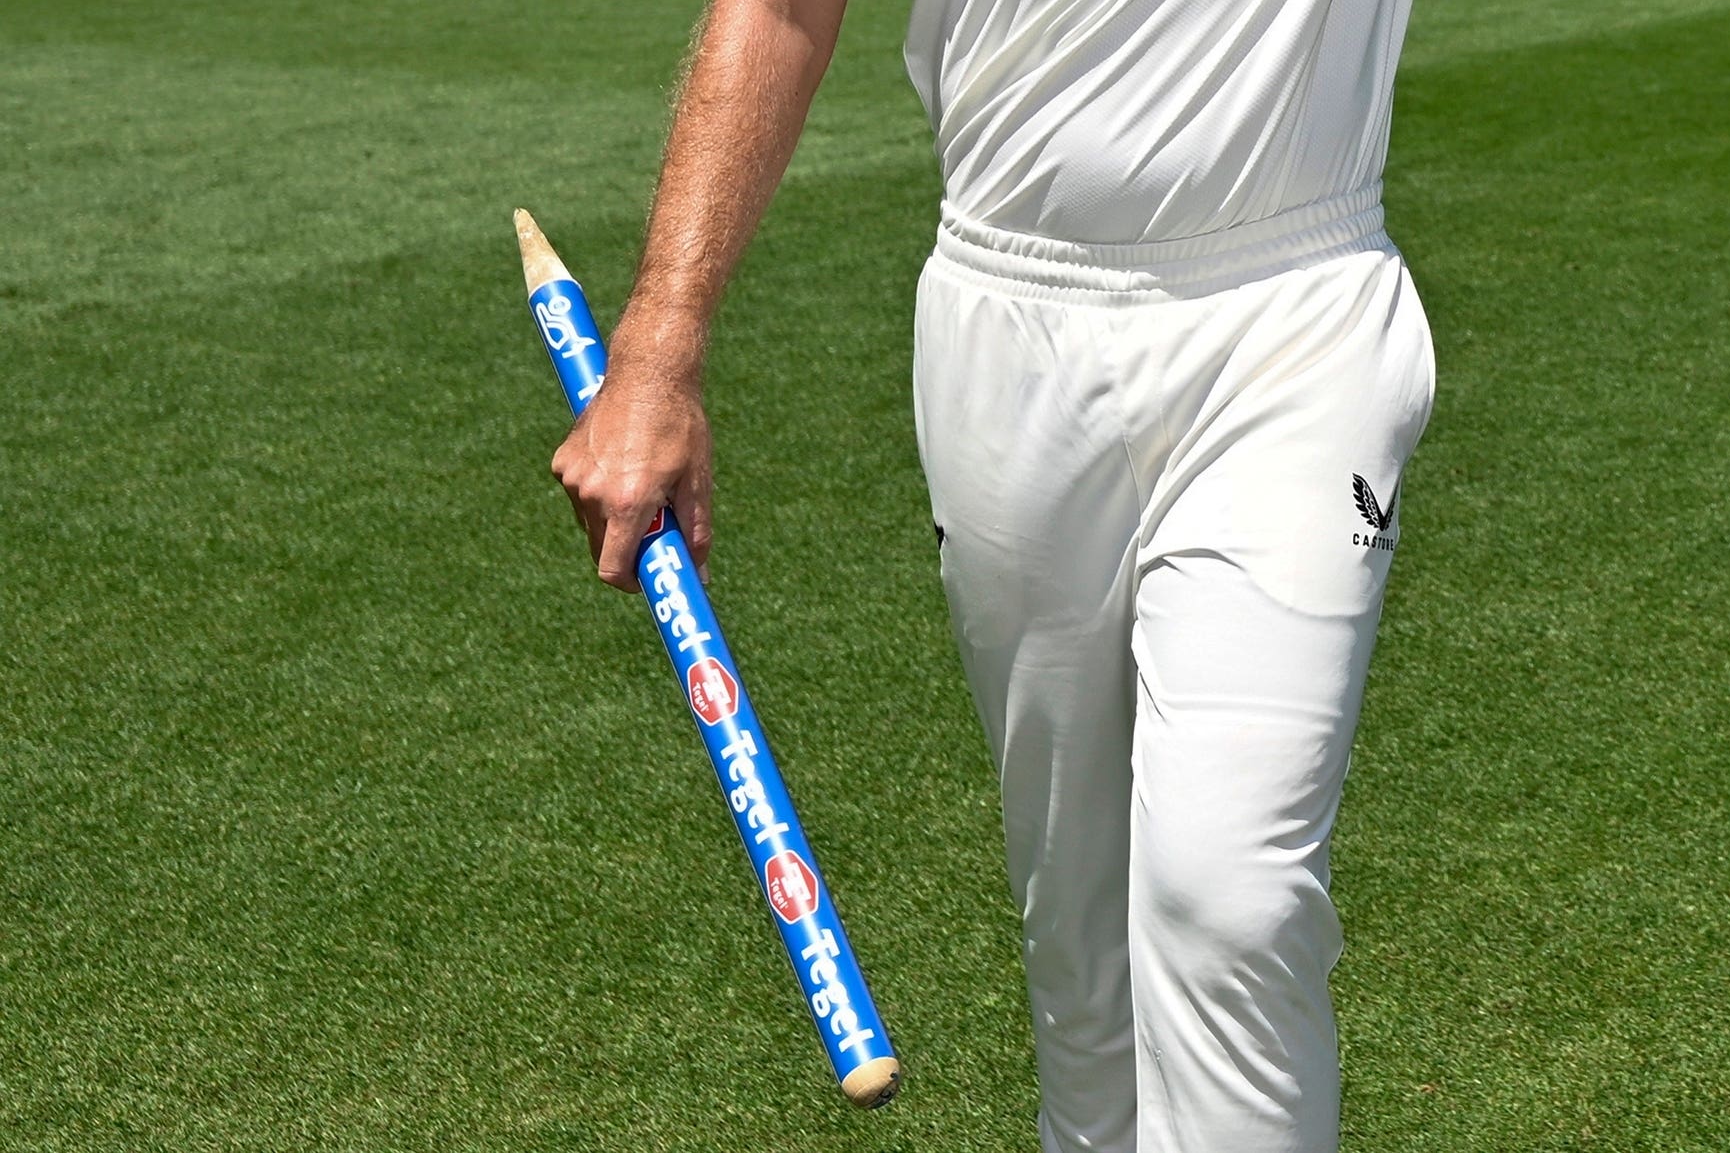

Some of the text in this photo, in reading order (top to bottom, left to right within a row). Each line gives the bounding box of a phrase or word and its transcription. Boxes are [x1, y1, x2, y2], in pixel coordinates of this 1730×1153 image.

[646, 545, 712, 653] Tegel
[720, 730, 790, 845] Tegel
[801, 928, 875, 1053] Tegel
